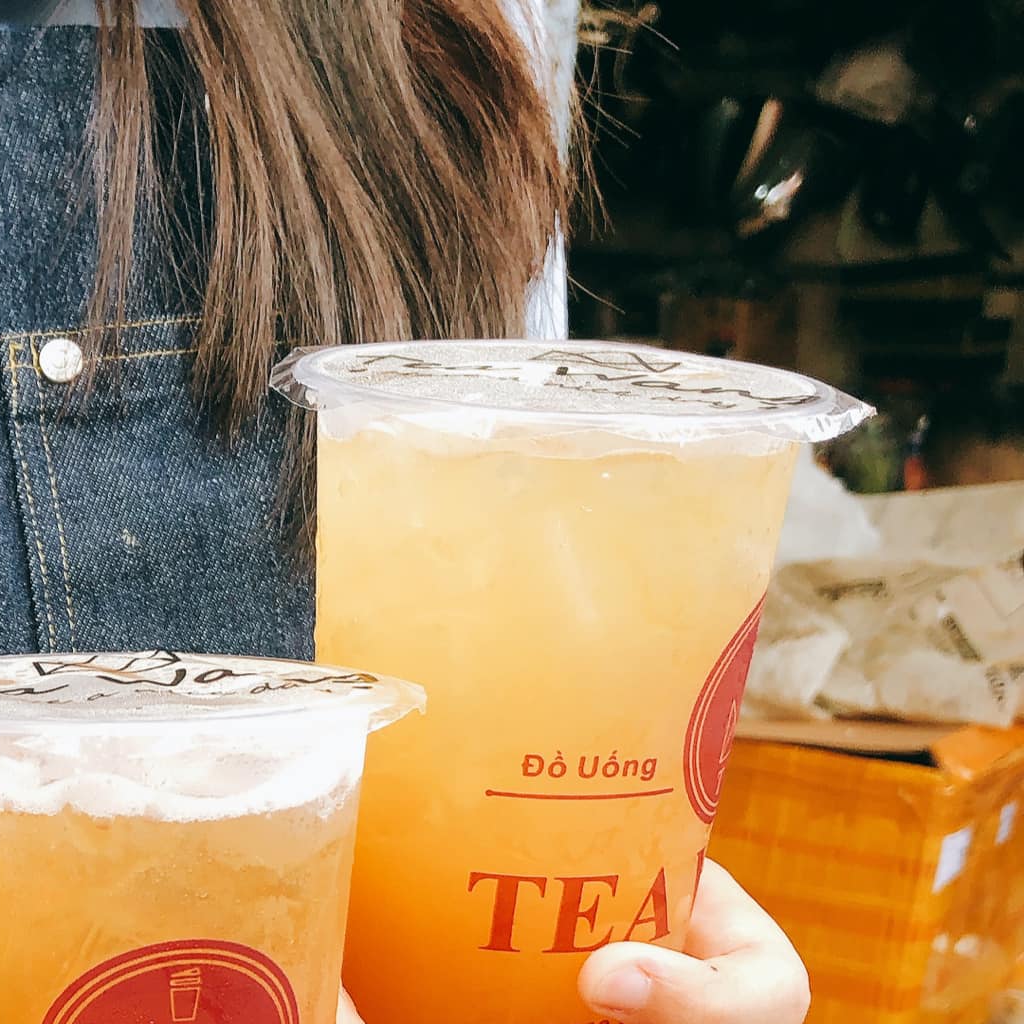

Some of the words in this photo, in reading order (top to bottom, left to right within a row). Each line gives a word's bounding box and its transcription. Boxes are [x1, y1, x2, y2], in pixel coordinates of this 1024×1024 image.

[521, 749, 568, 778] Đồ
[578, 748, 659, 781] Uống
[467, 866, 672, 955] TEA
